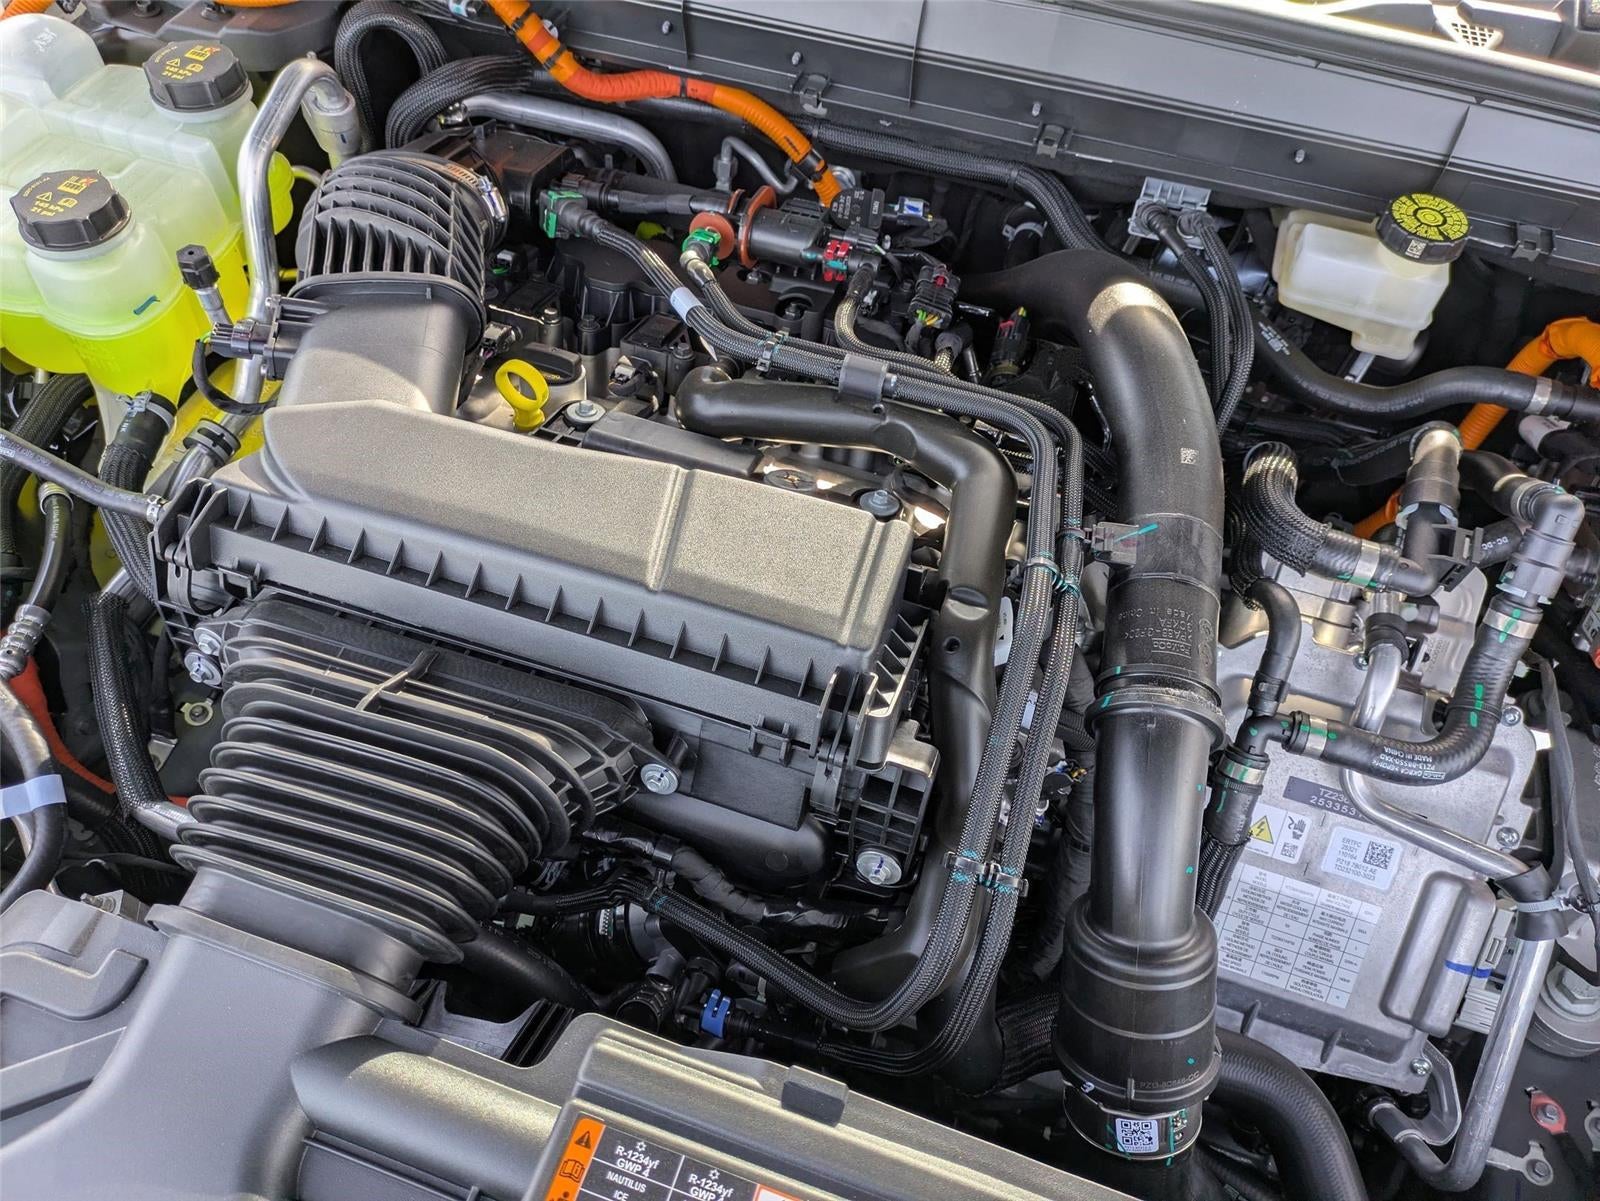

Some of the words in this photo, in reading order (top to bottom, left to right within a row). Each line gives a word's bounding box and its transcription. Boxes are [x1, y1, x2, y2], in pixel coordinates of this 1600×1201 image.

[1481, 536, 1509, 550] DC-DC
[1383, 746, 1407, 758] CHINA
[1413, 753, 1433, 763] MADE
[615, 1145, 660, 1169] R-1234yf
[616, 1157, 641, 1172] GWP
[641, 1168, 650, 1178] 4
[606, 1171, 647, 1193] NAUTILUS
[688, 1173, 734, 1199] R-1234yf
[613, 1189, 629, 1201] ICE
[690, 1187, 716, 1201] GWP
